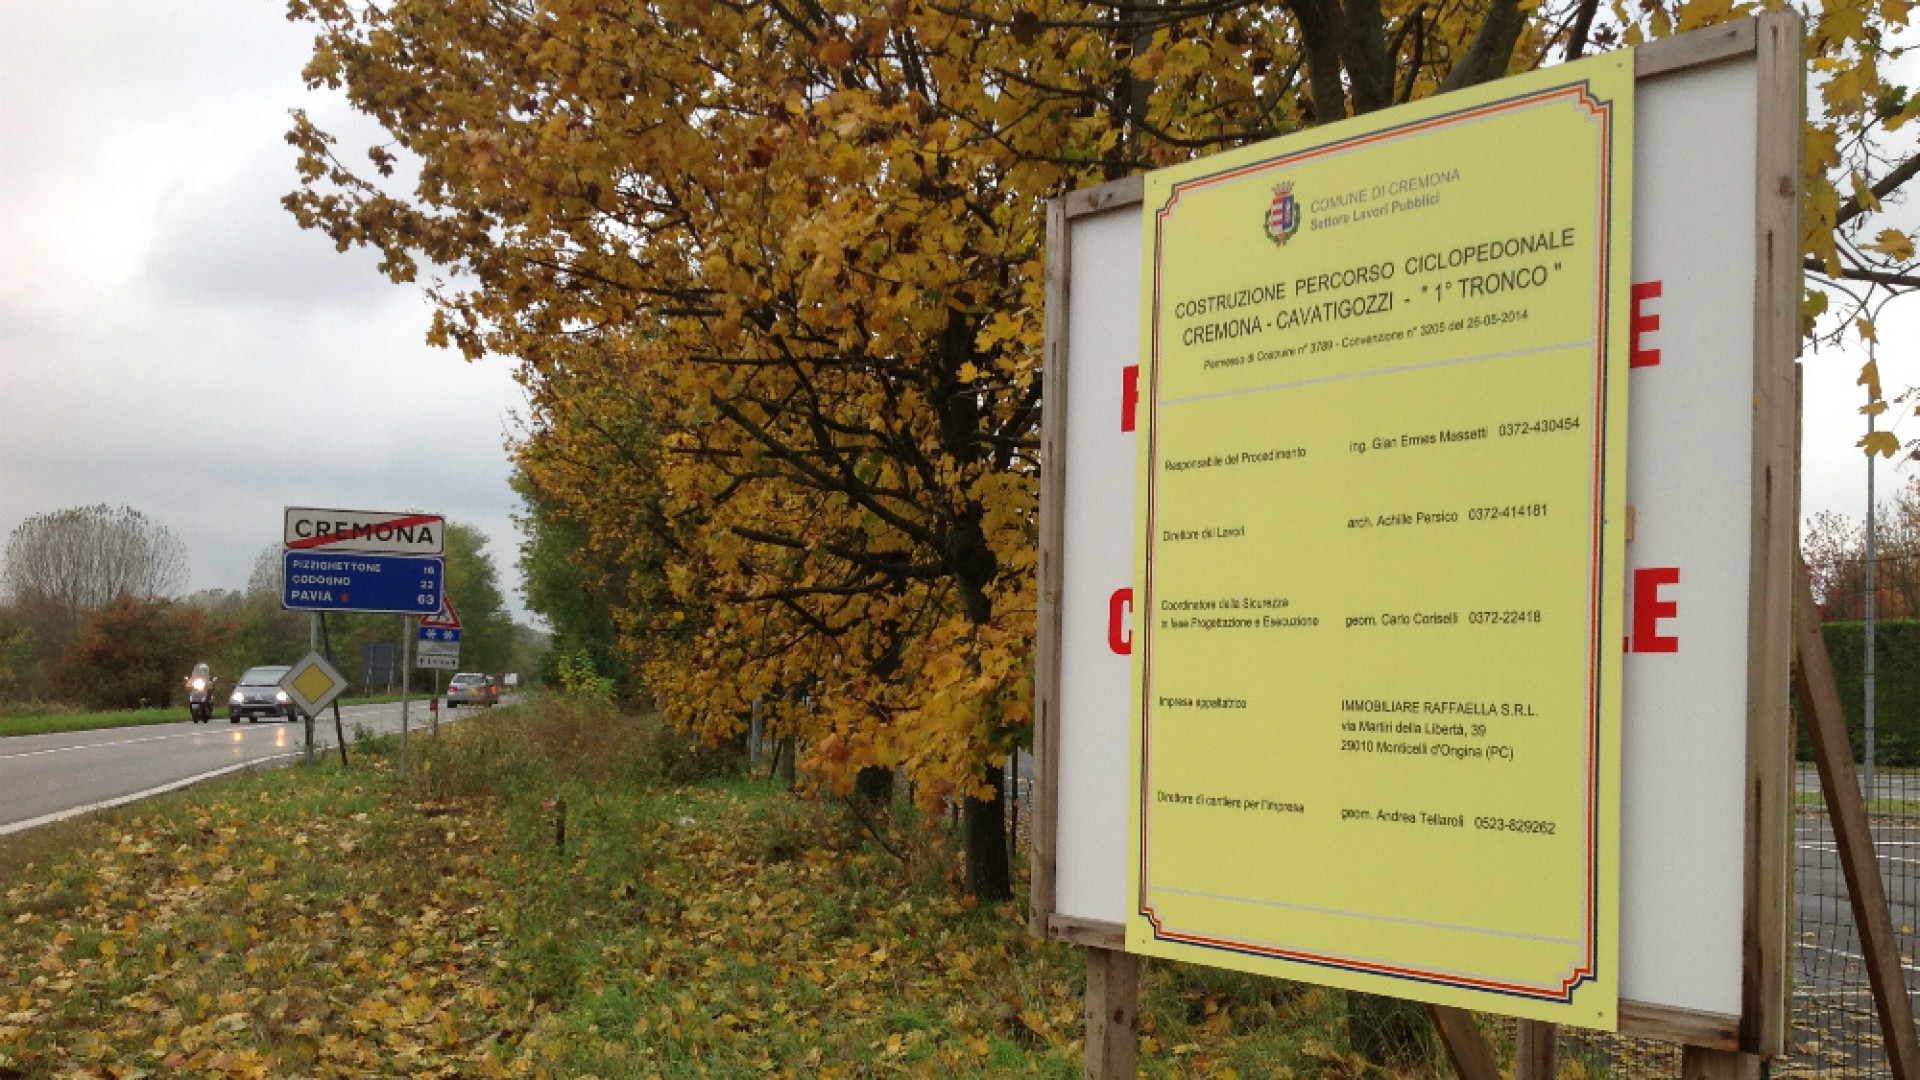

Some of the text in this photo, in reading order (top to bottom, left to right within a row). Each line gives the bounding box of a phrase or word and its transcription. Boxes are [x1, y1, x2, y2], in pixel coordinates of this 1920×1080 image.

[1311, 169, 1461, 213] COMUNE DI CREMONA
[1311, 192, 1441, 231] Settore Lavori Pubblici
[1175, 227, 1575, 319] COSTRUZIONE PERCORSO CICLOPEDONALE
[1182, 316, 1262, 346] CREMONA
[1276, 291, 1393, 330] CAVATIGOZZI
[1458, 265, 1548, 299] TRONCO
[1203, 355, 1245, 371] Permesso
[1247, 354, 1255, 364] di
[1257, 347, 1296, 363] Costruire
[1341, 330, 1404, 348] Convenzione
[1448, 318, 1464, 331] del
[1372, 436, 1397, 450] Gian
[1401, 433, 1437, 448] Ermes
[1439, 425, 1488, 444] Massetti
[1498, 417, 1581, 437] 0372-430454
[1164, 446, 1307, 472] Responsabile del Procedimento
[1376, 512, 1413, 527] Achille
[1416, 510, 1458, 525] Persico
[1468, 503, 1548, 521] 0372-414181
[295, 519, 434, 545] CREMONA
[1162, 528, 1199, 542] Direttore
[1217, 525, 1245, 538] Lavori
[293, 559, 381, 573] PIZZIGHETTONE
[291, 575, 351, 586] CODOGNO
[291, 590, 332, 602] PAVIA
[1161, 599, 1216, 611] Coordinatore
[1242, 597, 1289, 609] Sicurezza
[1190, 616, 1252, 630] Progettazione
[1262, 615, 1319, 628] Esecuzione
[1345, 616, 1377, 629] geom.
[1381, 613, 1410, 626] Carlo
[1468, 609, 1542, 625] 0372-22418
[1159, 695, 1193, 709] Impresa
[1341, 699, 1539, 717] IMMOBILIARE RAFFAELLA S.R.L.
[1341, 720, 1356, 732] via
[1358, 720, 1392, 733] Martiri
[1395, 721, 1422, 735] della
[1341, 739, 1374, 753] 29010
[1376, 740, 1427, 755] Monticelli
[1485, 745, 1514, 762] (PC)
[1157, 790, 1193, 804] Direttore
[1243, 799, 1259, 812] per
[1341, 808, 1556, 836] geom. Andrea Tellaroli 0523-829262
